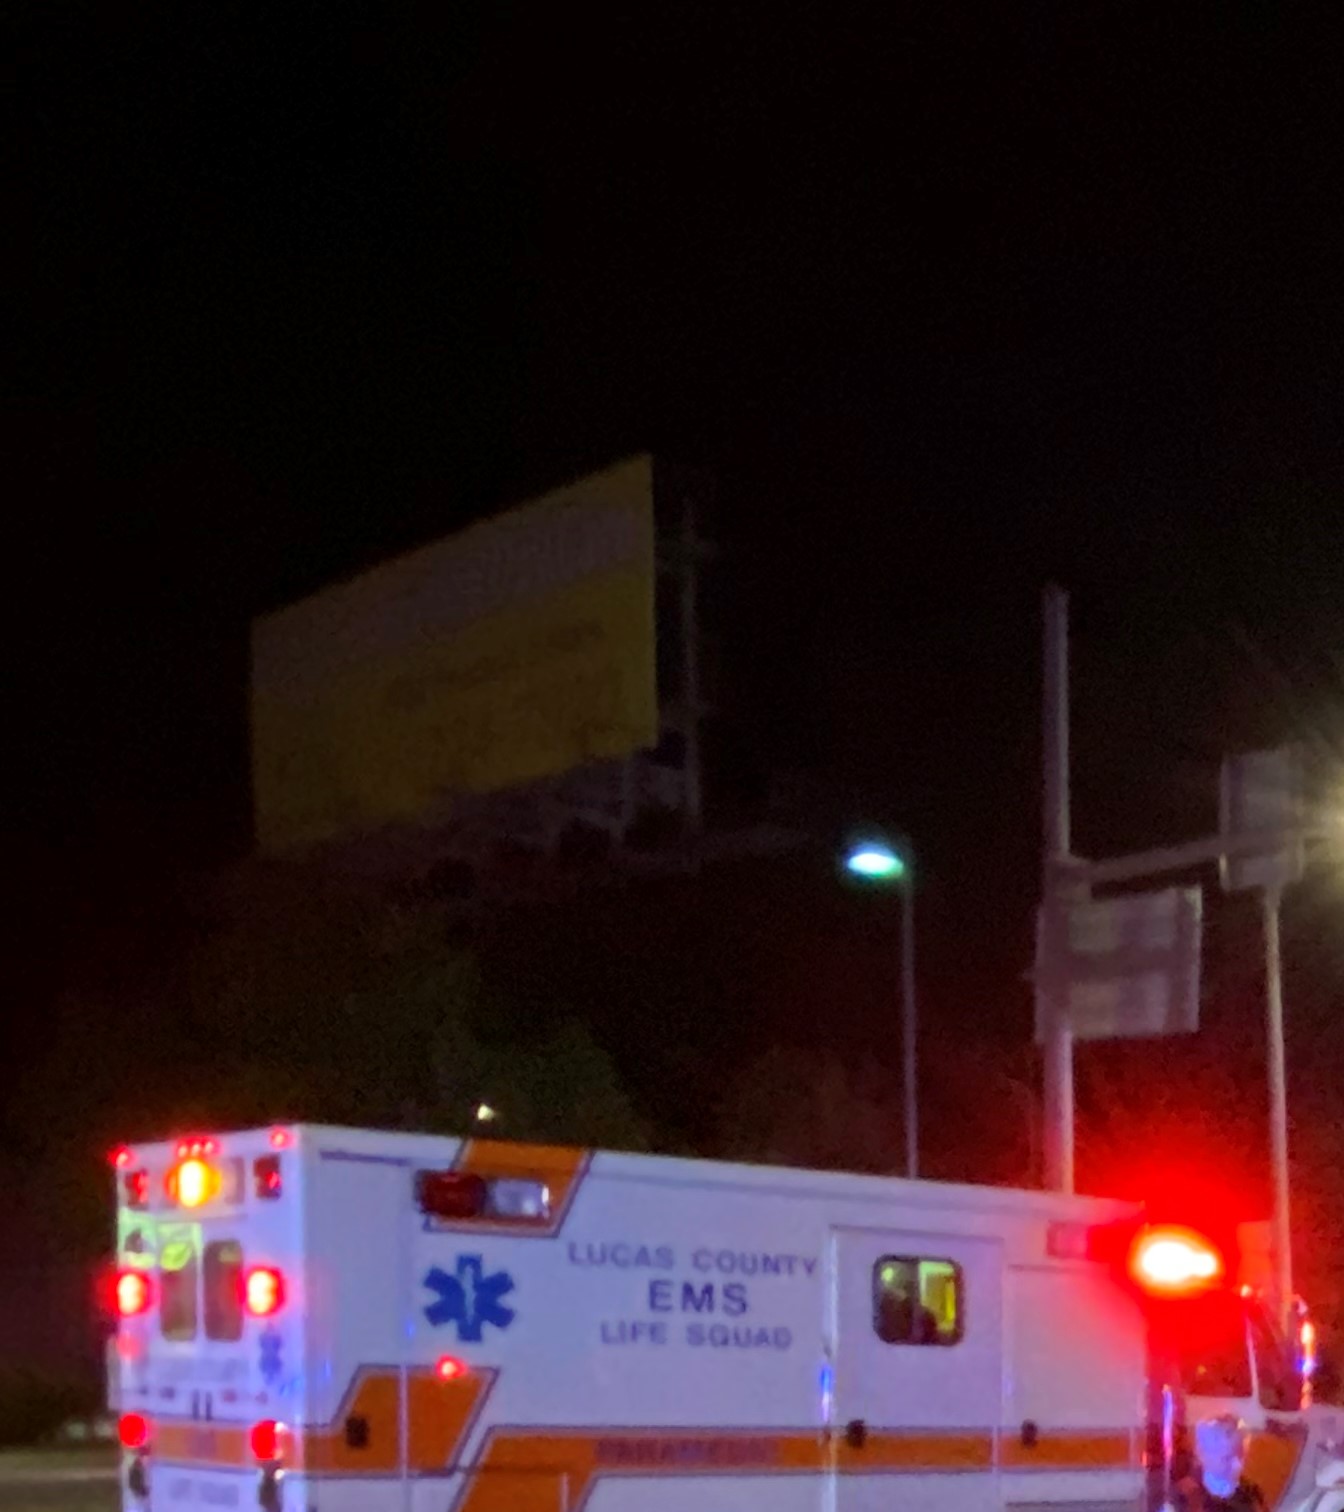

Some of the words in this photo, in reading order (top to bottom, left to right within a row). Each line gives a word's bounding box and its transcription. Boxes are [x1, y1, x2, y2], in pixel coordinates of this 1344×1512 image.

[568, 1241, 674, 1270] LUCAS
[692, 1248, 818, 1275] COUNTY
[649, 1279, 748, 1316] EMS
[601, 1320, 667, 1345] LIFE
[686, 1323, 793, 1349] SQUAD
